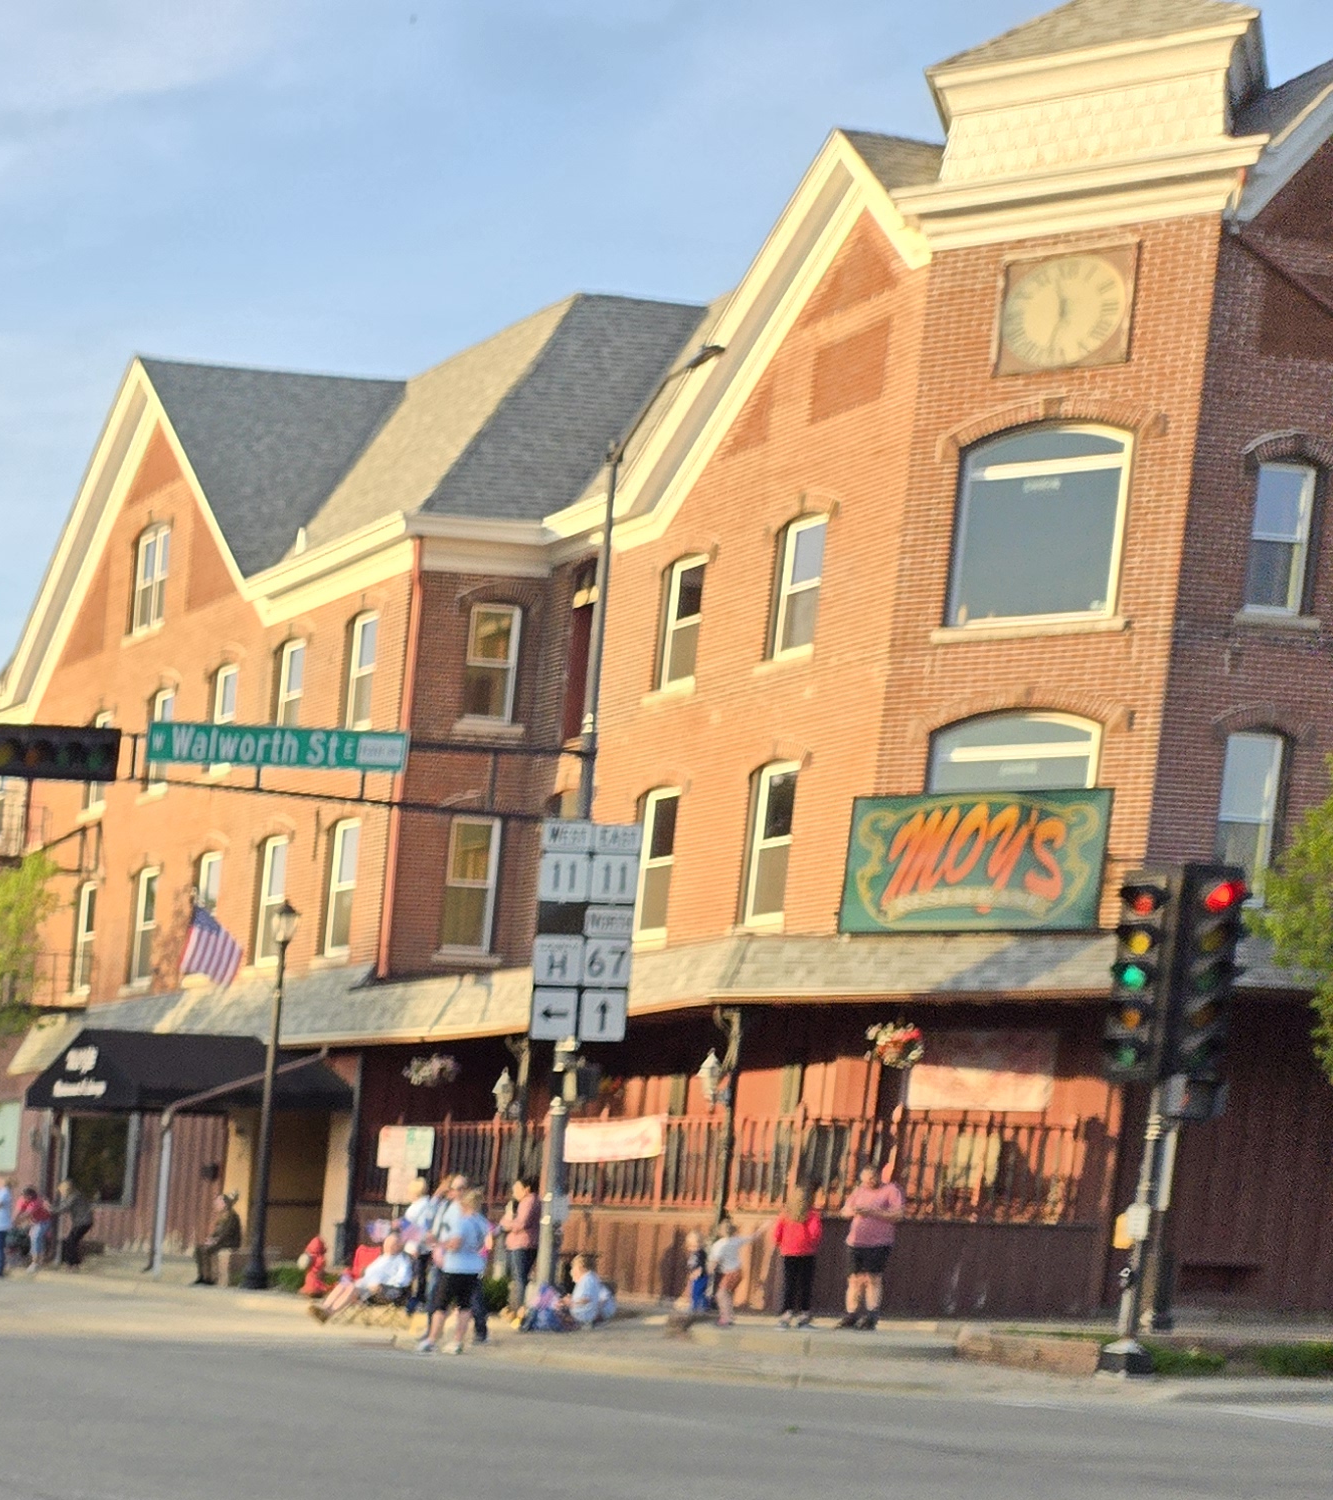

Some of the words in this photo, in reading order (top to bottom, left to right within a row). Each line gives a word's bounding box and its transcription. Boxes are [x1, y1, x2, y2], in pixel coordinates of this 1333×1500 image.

[171, 725, 299, 765] Walworth
[306, 731, 339, 766] St
[552, 861, 577, 893] 11
[603, 862, 628, 895] 11
[587, 946, 628, 978] 67
